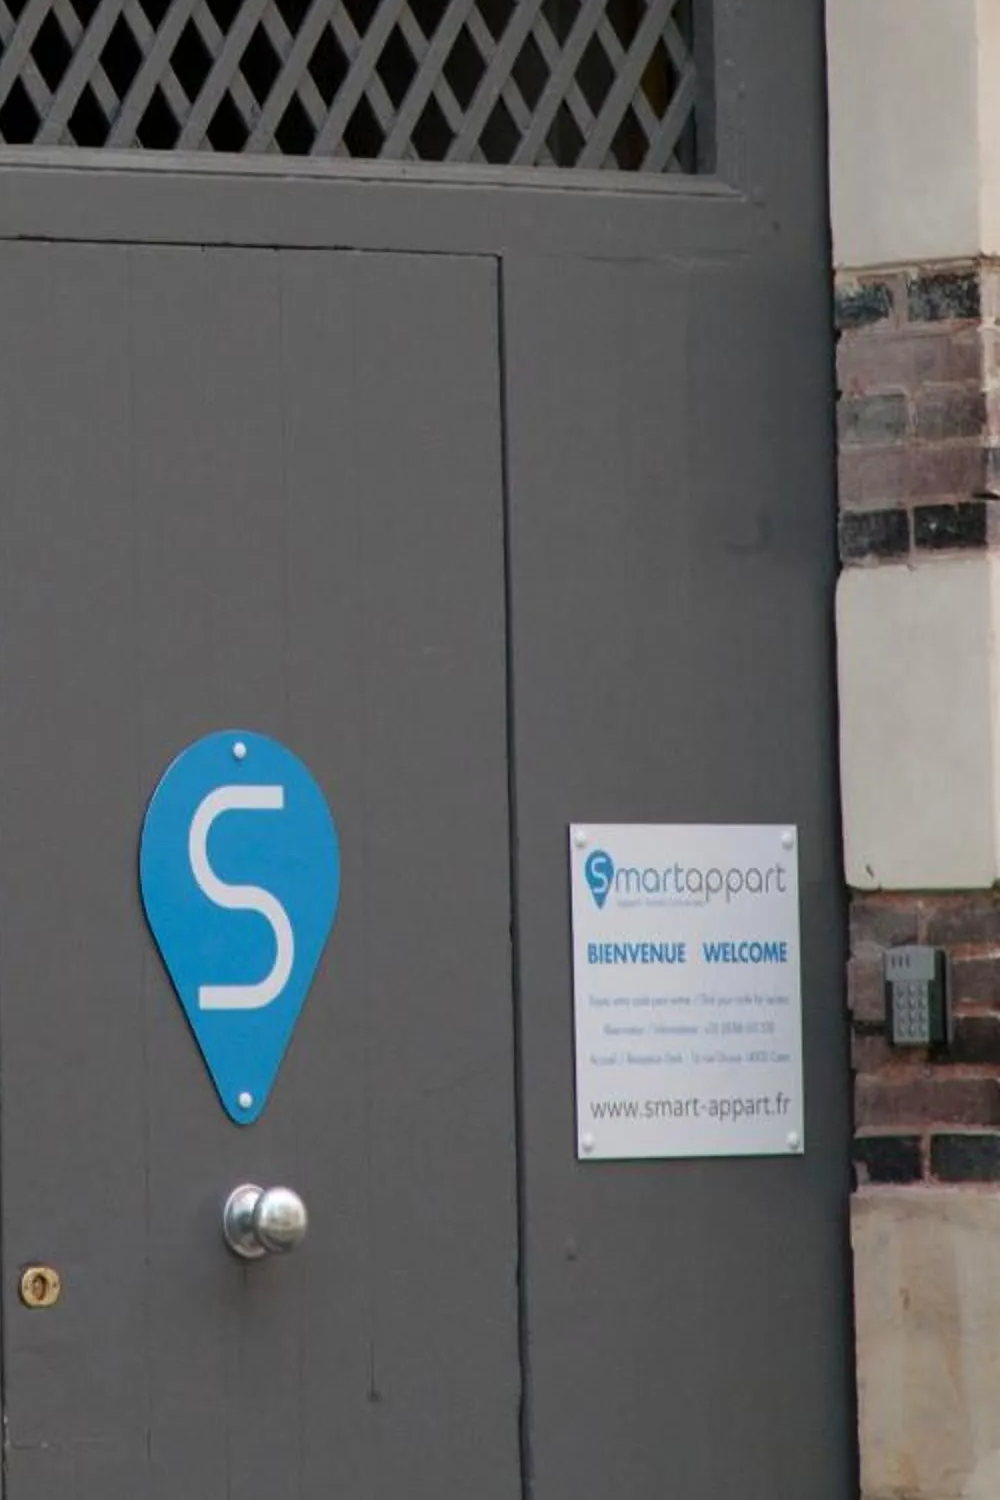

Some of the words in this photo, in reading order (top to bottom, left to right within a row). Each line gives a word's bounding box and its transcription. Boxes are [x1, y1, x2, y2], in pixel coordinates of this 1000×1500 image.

[188, 784, 295, 1010] S
[587, 941, 686, 964] BIENVENUE
[703, 941, 788, 964] WELCOME
[590, 1092, 792, 1122] www.smart-appart.fr
